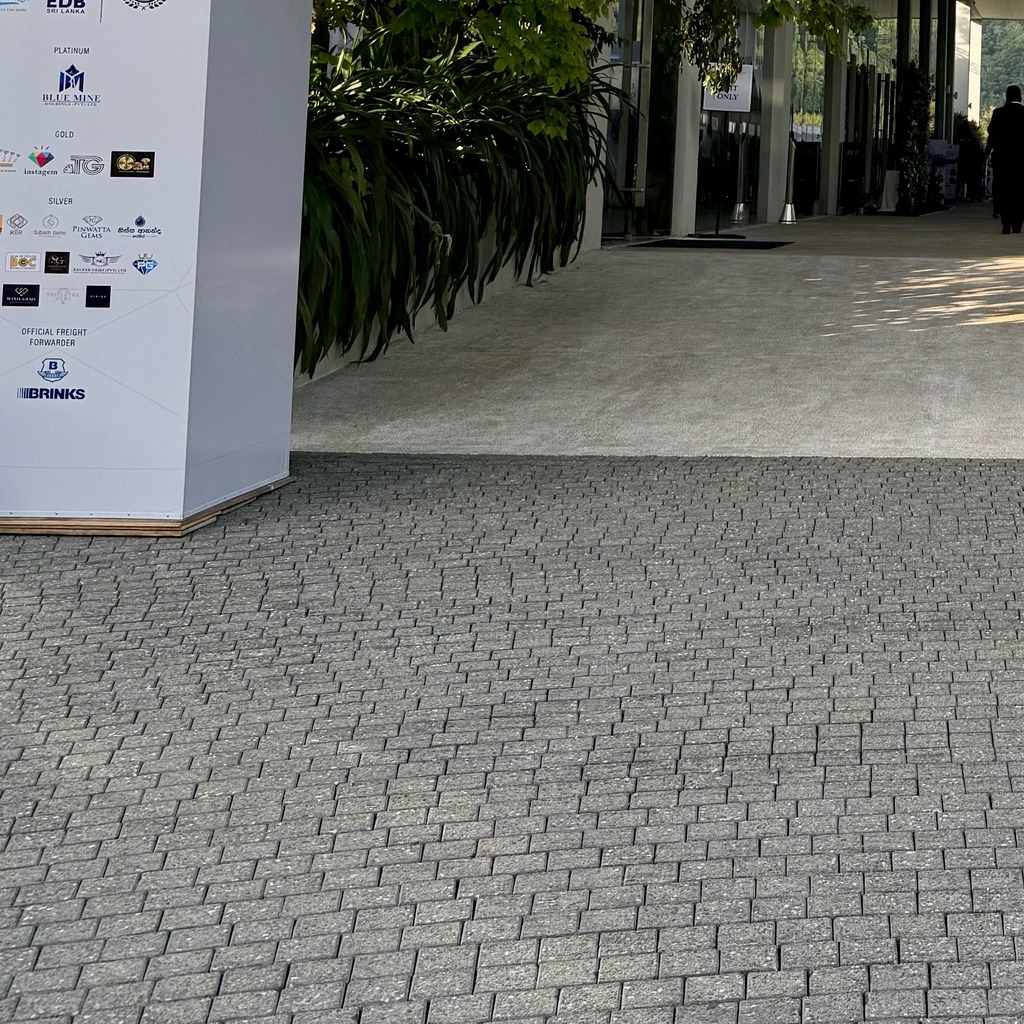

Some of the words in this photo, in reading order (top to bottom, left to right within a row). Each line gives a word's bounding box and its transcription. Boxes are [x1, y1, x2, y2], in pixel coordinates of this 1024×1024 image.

[53, 47, 90, 55] PLATINUM
[42, 93, 70, 102] BLUE
[73, 94, 101, 103] MINE
[717, 93, 739, 101] ONLY
[24, 168, 58, 176] instagem
[48, 197, 73, 205] SILVER
[137, 261, 154, 269] PG
[21, 327, 54, 336] OFFICIAL
[56, 328, 88, 336] FREIGHT
[29, 338, 76, 347] FORWARDER
[49, 361, 58, 370] B
[28, 387, 86, 400] BRINKS
